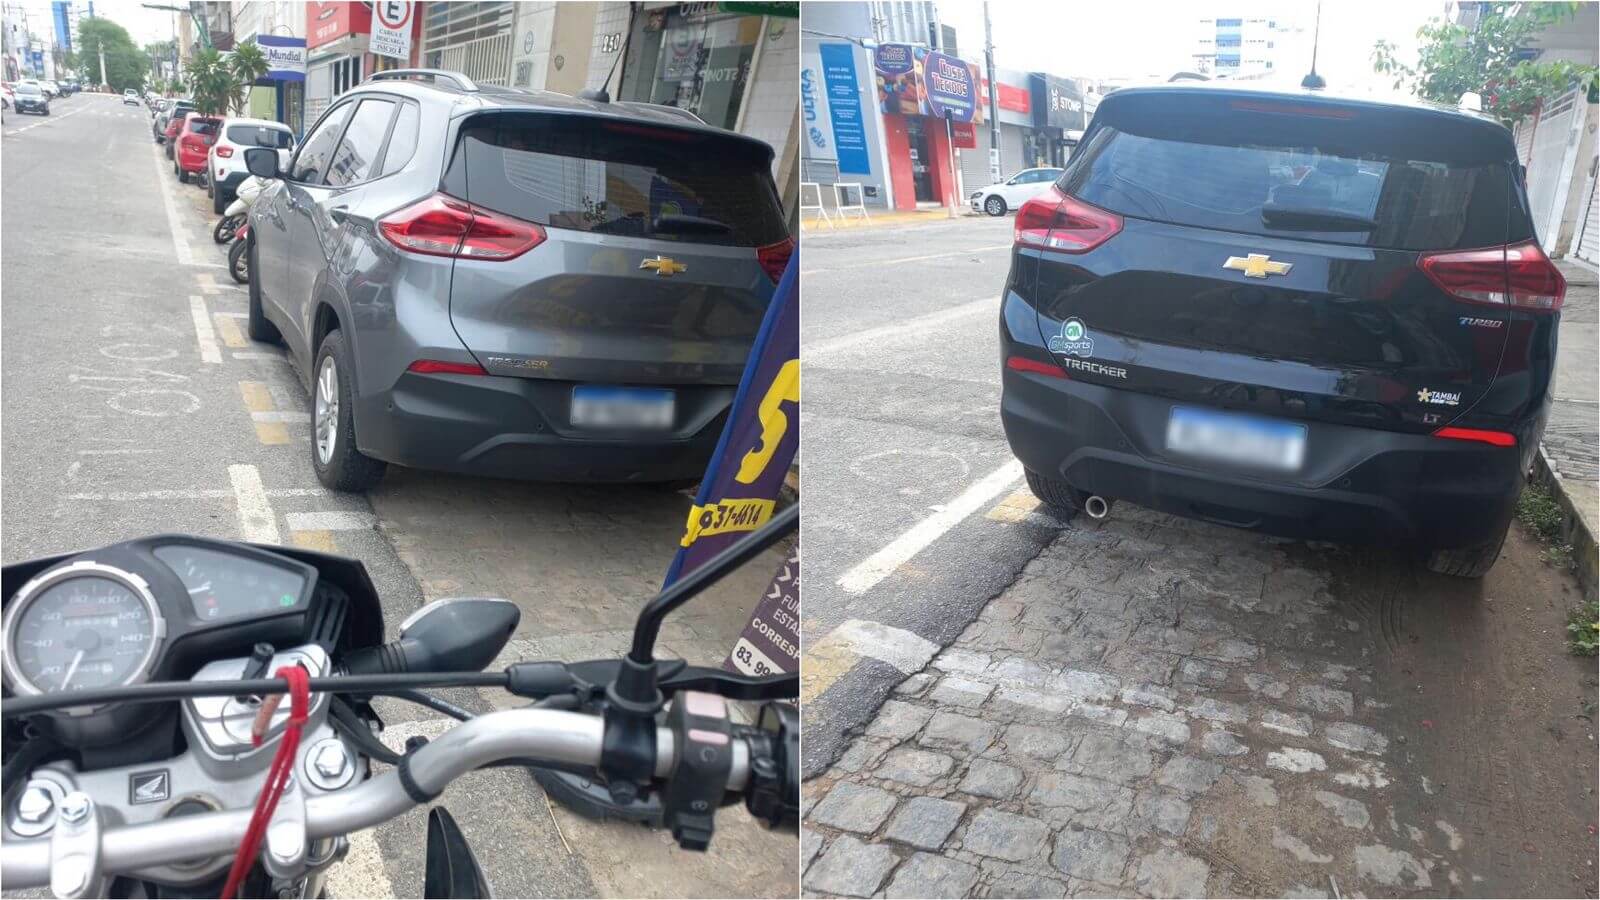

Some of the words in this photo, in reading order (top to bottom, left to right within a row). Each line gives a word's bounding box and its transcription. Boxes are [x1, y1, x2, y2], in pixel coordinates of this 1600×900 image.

[387, 1, 399, 20] E
[269, 49, 301, 61] Mundial
[1060, 96, 1081, 112] STOMP
[1459, 316, 1503, 328] TURBO
[1064, 357, 1128, 379] TRACKER
[1424, 412, 1441, 423] LT
